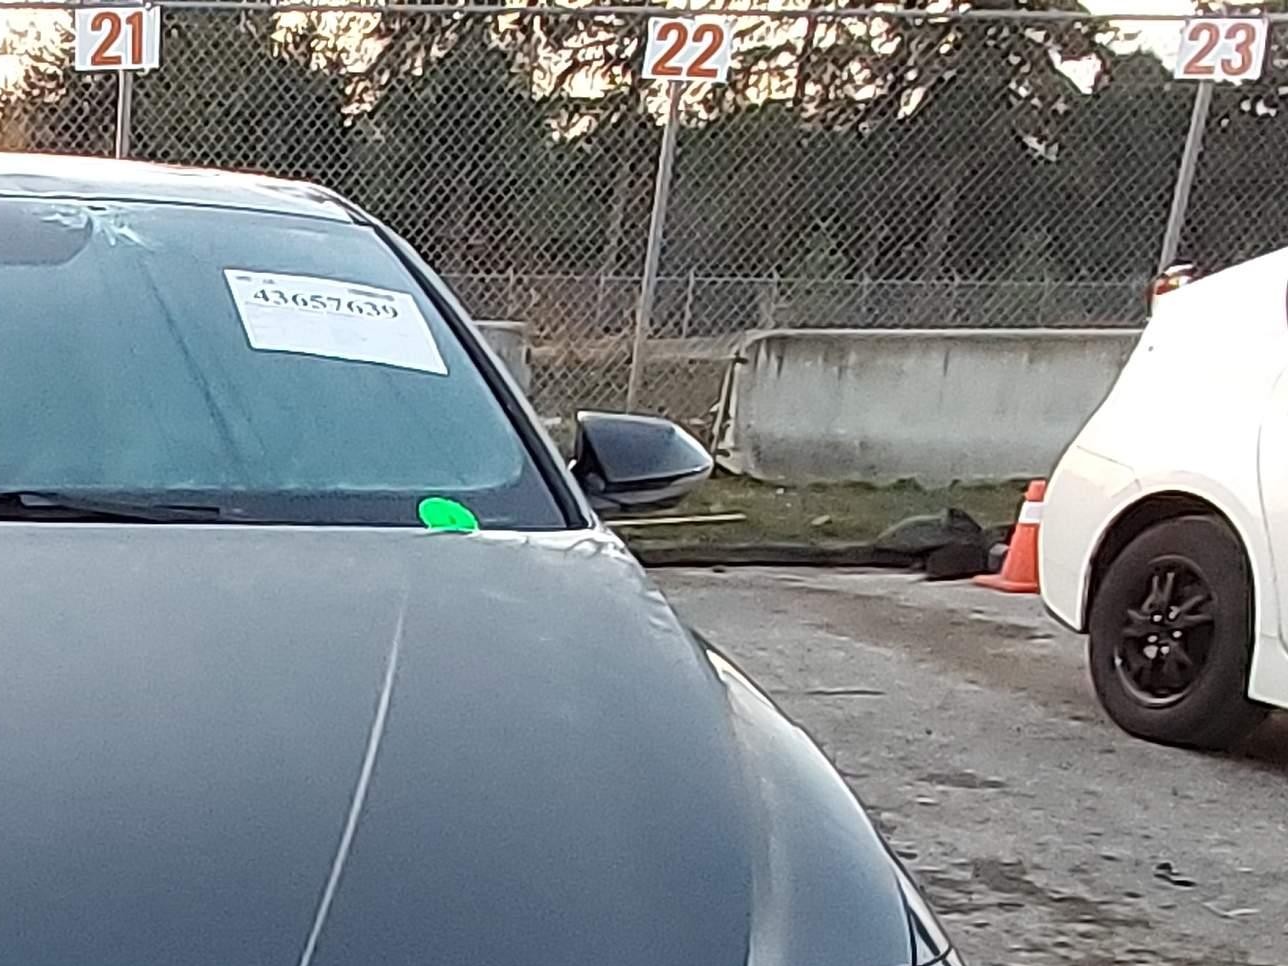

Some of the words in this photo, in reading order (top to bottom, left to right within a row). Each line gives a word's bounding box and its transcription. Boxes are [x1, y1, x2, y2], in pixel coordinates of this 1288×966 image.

[91, 11, 143, 65] 21
[651, 21, 724, 77] 22
[1183, 22, 1256, 76] 23
[253, 288, 399, 320] 43657639
